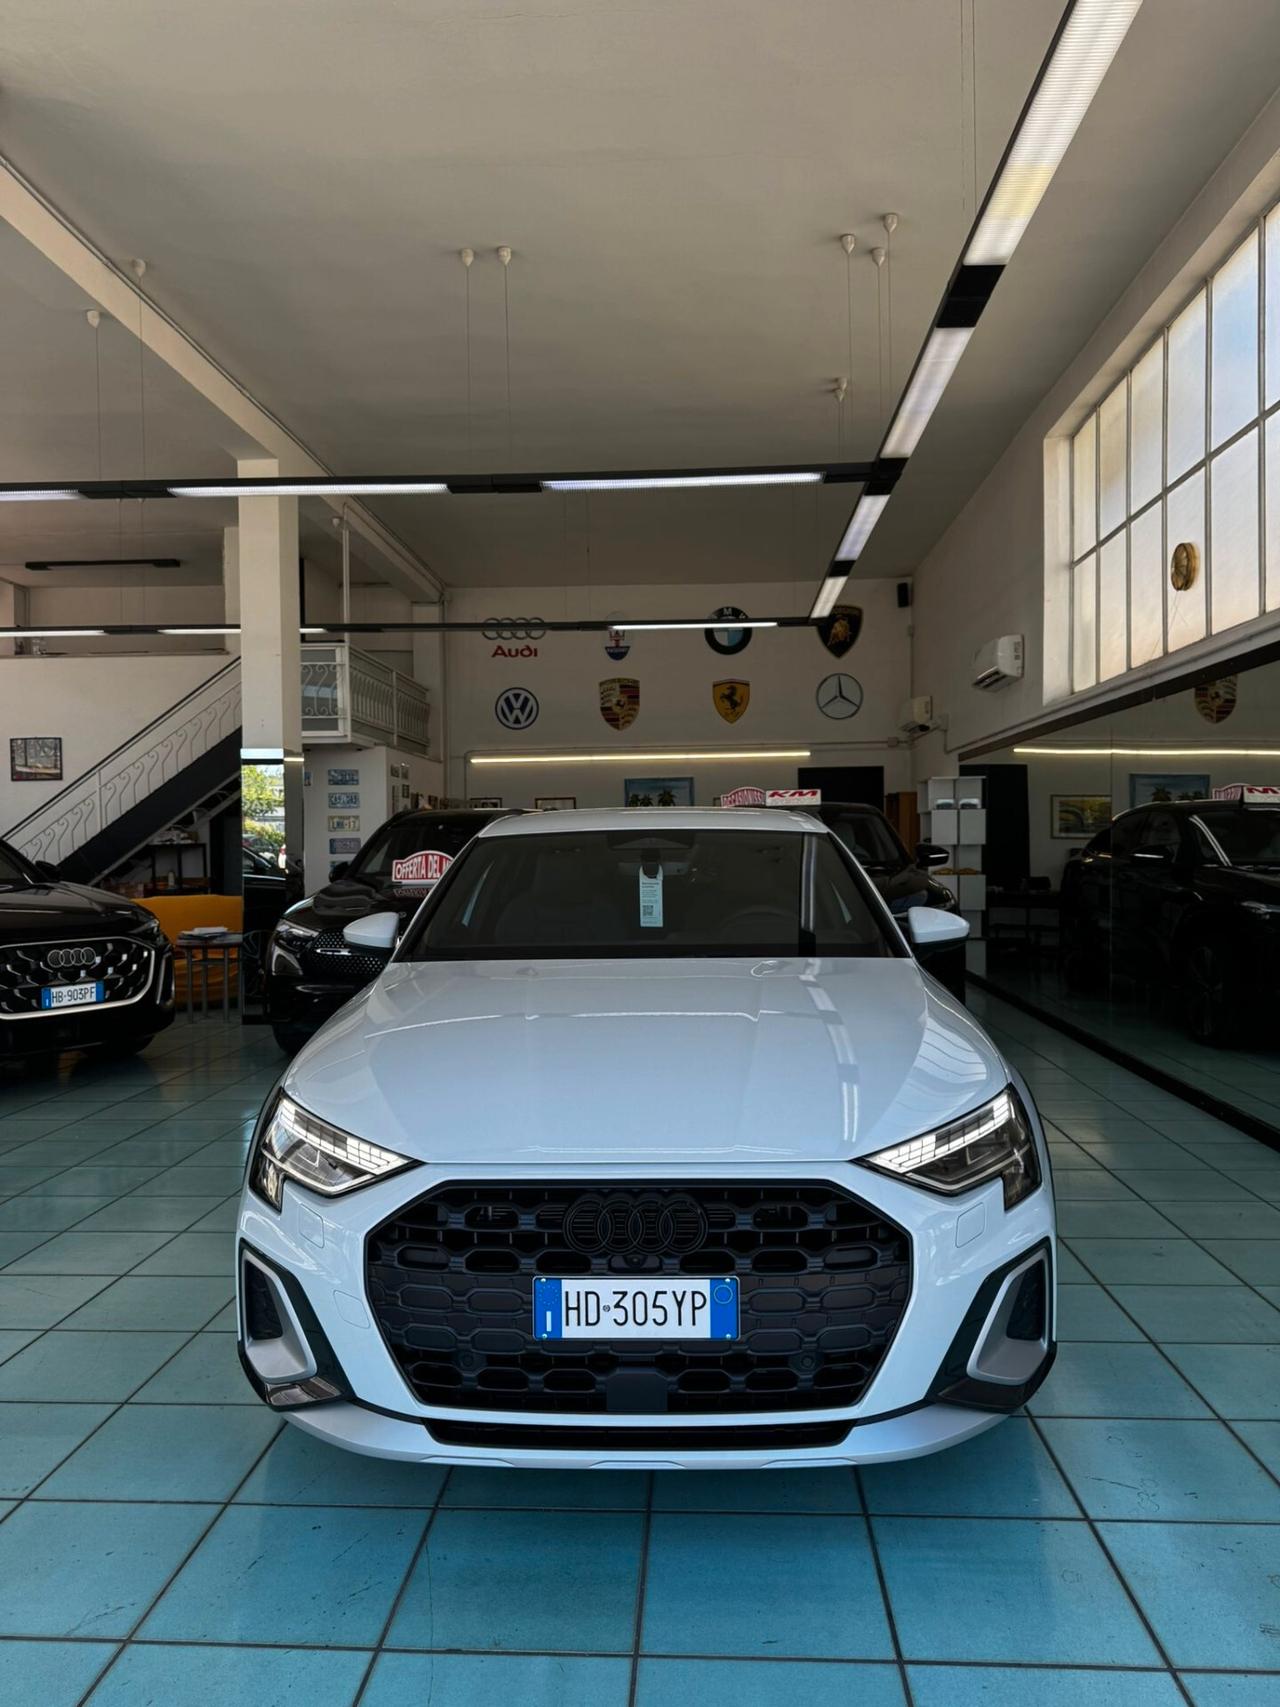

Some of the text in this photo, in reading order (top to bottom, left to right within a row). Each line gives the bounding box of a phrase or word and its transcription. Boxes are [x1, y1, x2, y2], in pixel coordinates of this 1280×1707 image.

[492, 645, 538, 658] Audi
[501, 692, 535, 725] VW
[768, 790, 818, 798] KM
[396, 855, 426, 879] OFFERTA
[427, 854, 441, 879] DEL
